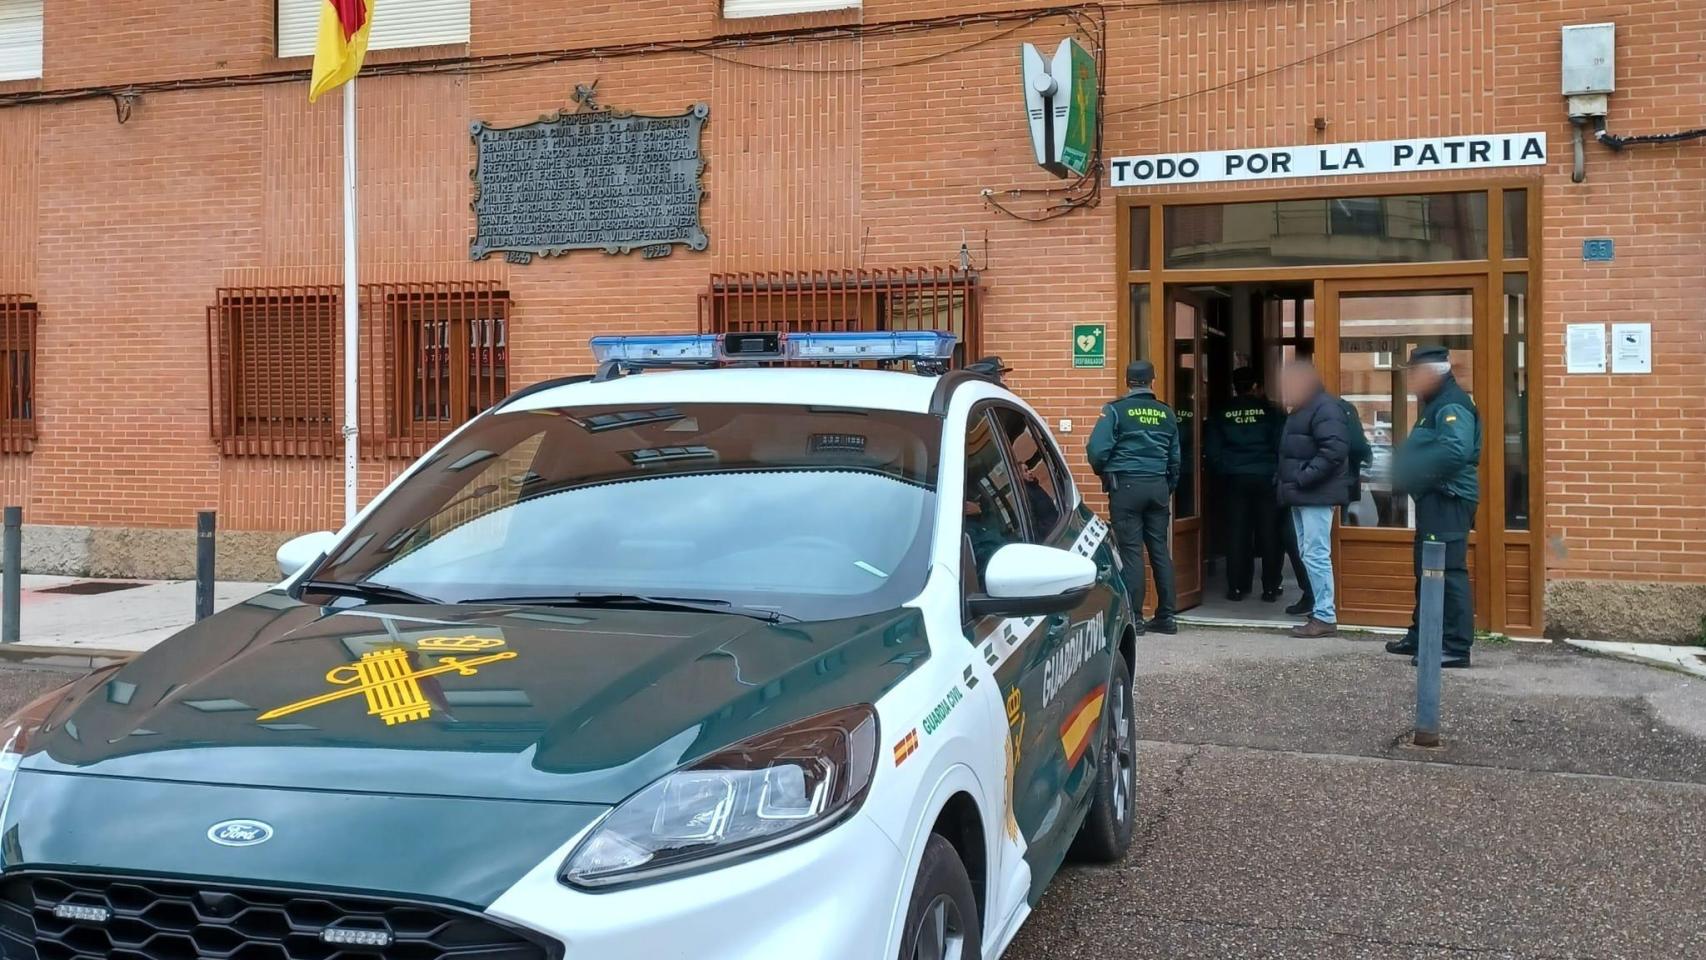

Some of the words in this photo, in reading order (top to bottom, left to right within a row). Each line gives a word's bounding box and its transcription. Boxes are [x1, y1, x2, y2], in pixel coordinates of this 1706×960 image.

[483, 140, 537, 153] BENAVENTE
[643, 128, 689, 141] COMARCA
[1112, 158, 1200, 182] TODO
[1225, 152, 1292, 176] POR
[1320, 148, 1365, 170] LA
[1394, 137, 1545, 166] PATRIA
[624, 162, 671, 175] FUENTES
[637, 172, 685, 186] MORALES
[1127, 408, 1167, 419] GUARDIA
[1139, 416, 1160, 426] CIVIL
[1042, 628, 1084, 709] GUARDIA
[1084, 610, 1107, 662] CIVIL
[922, 698, 951, 735] GUARDIA
[946, 685, 963, 708] CIVIL
[220, 824, 260, 840] Ford
